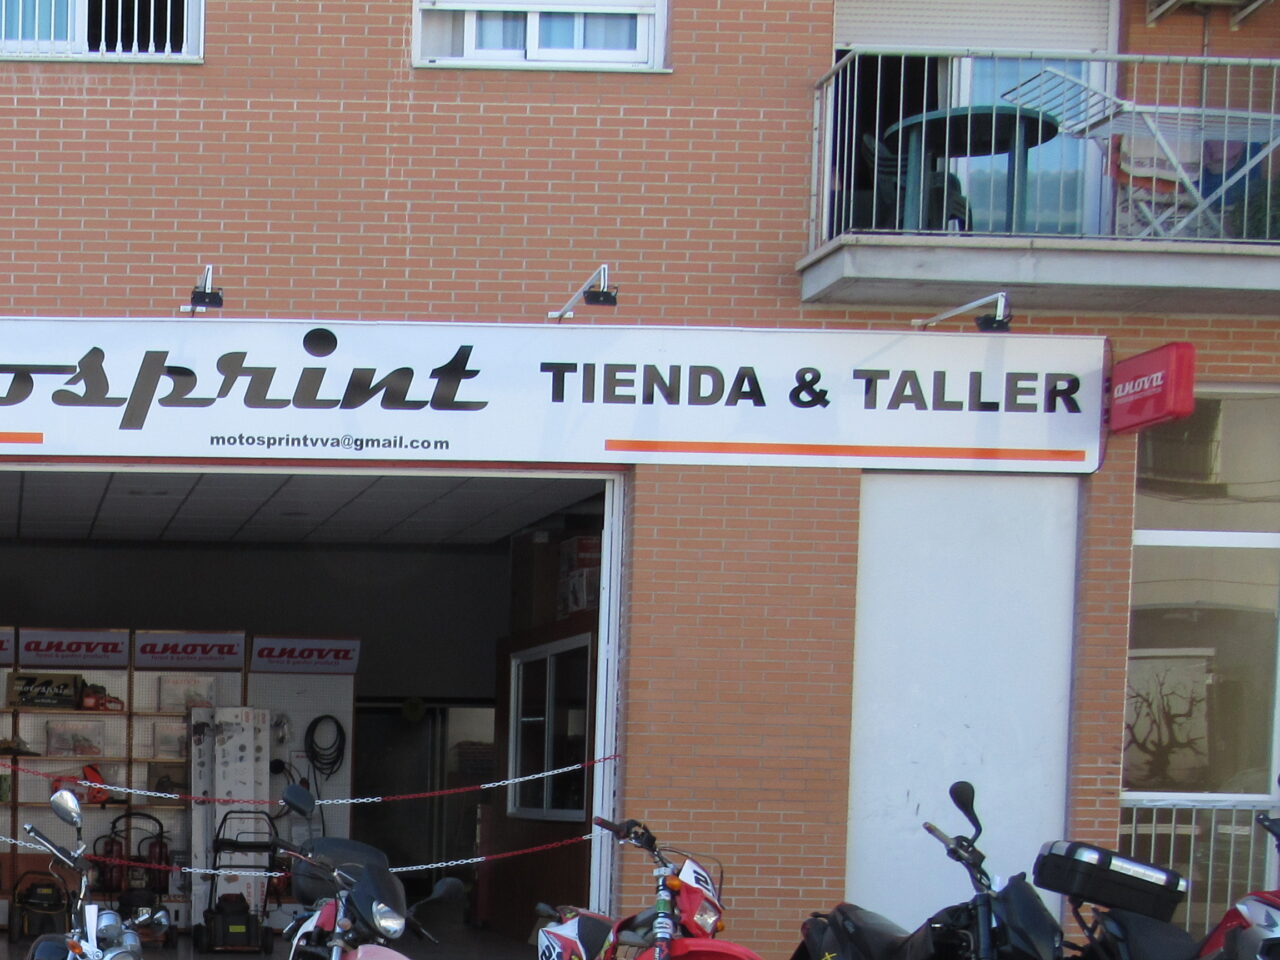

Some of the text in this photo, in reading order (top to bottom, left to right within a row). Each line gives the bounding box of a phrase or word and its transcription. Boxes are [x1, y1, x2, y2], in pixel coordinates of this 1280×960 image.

[540, 362, 1083, 414] TIENDA & TALLER
[210, 433, 450, 451] motosprintvva@gmail.com
[24, 640, 123, 654] anova
[140, 642, 238, 656] anova
[258, 646, 353, 660] anova
